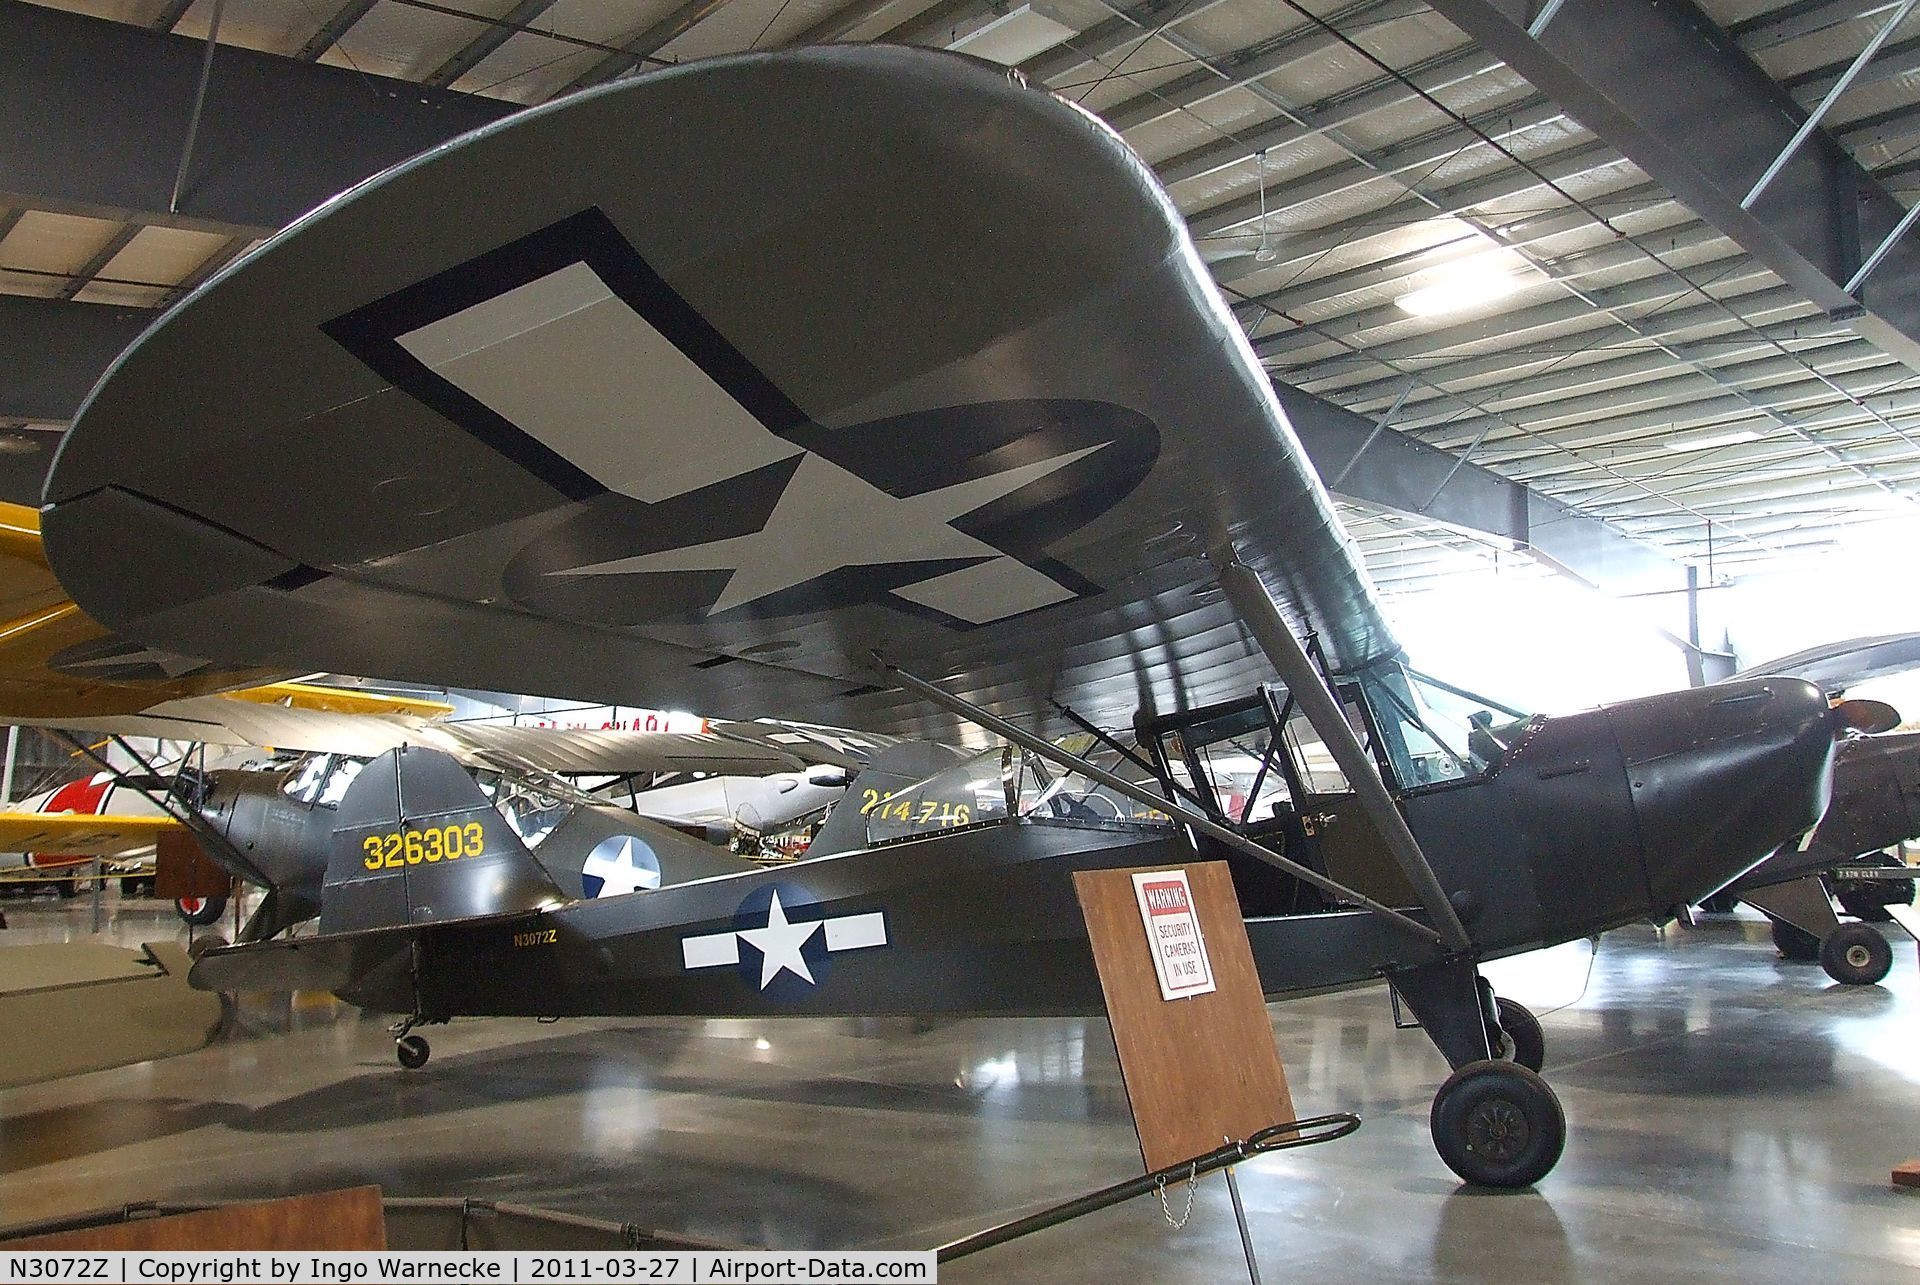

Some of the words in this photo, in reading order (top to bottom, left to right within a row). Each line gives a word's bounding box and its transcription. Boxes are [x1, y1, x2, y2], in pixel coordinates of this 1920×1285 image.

[363, 822, 485, 870] 326303
[1146, 886, 1187, 910] WARNING
[513, 929, 557, 947] N3072Z
[1158, 922, 1191, 939] SECURITY
[1164, 941, 1197, 958] CAMERAS
[1173, 963, 1182, 977] IN
[1182, 960, 1198, 975] USE
